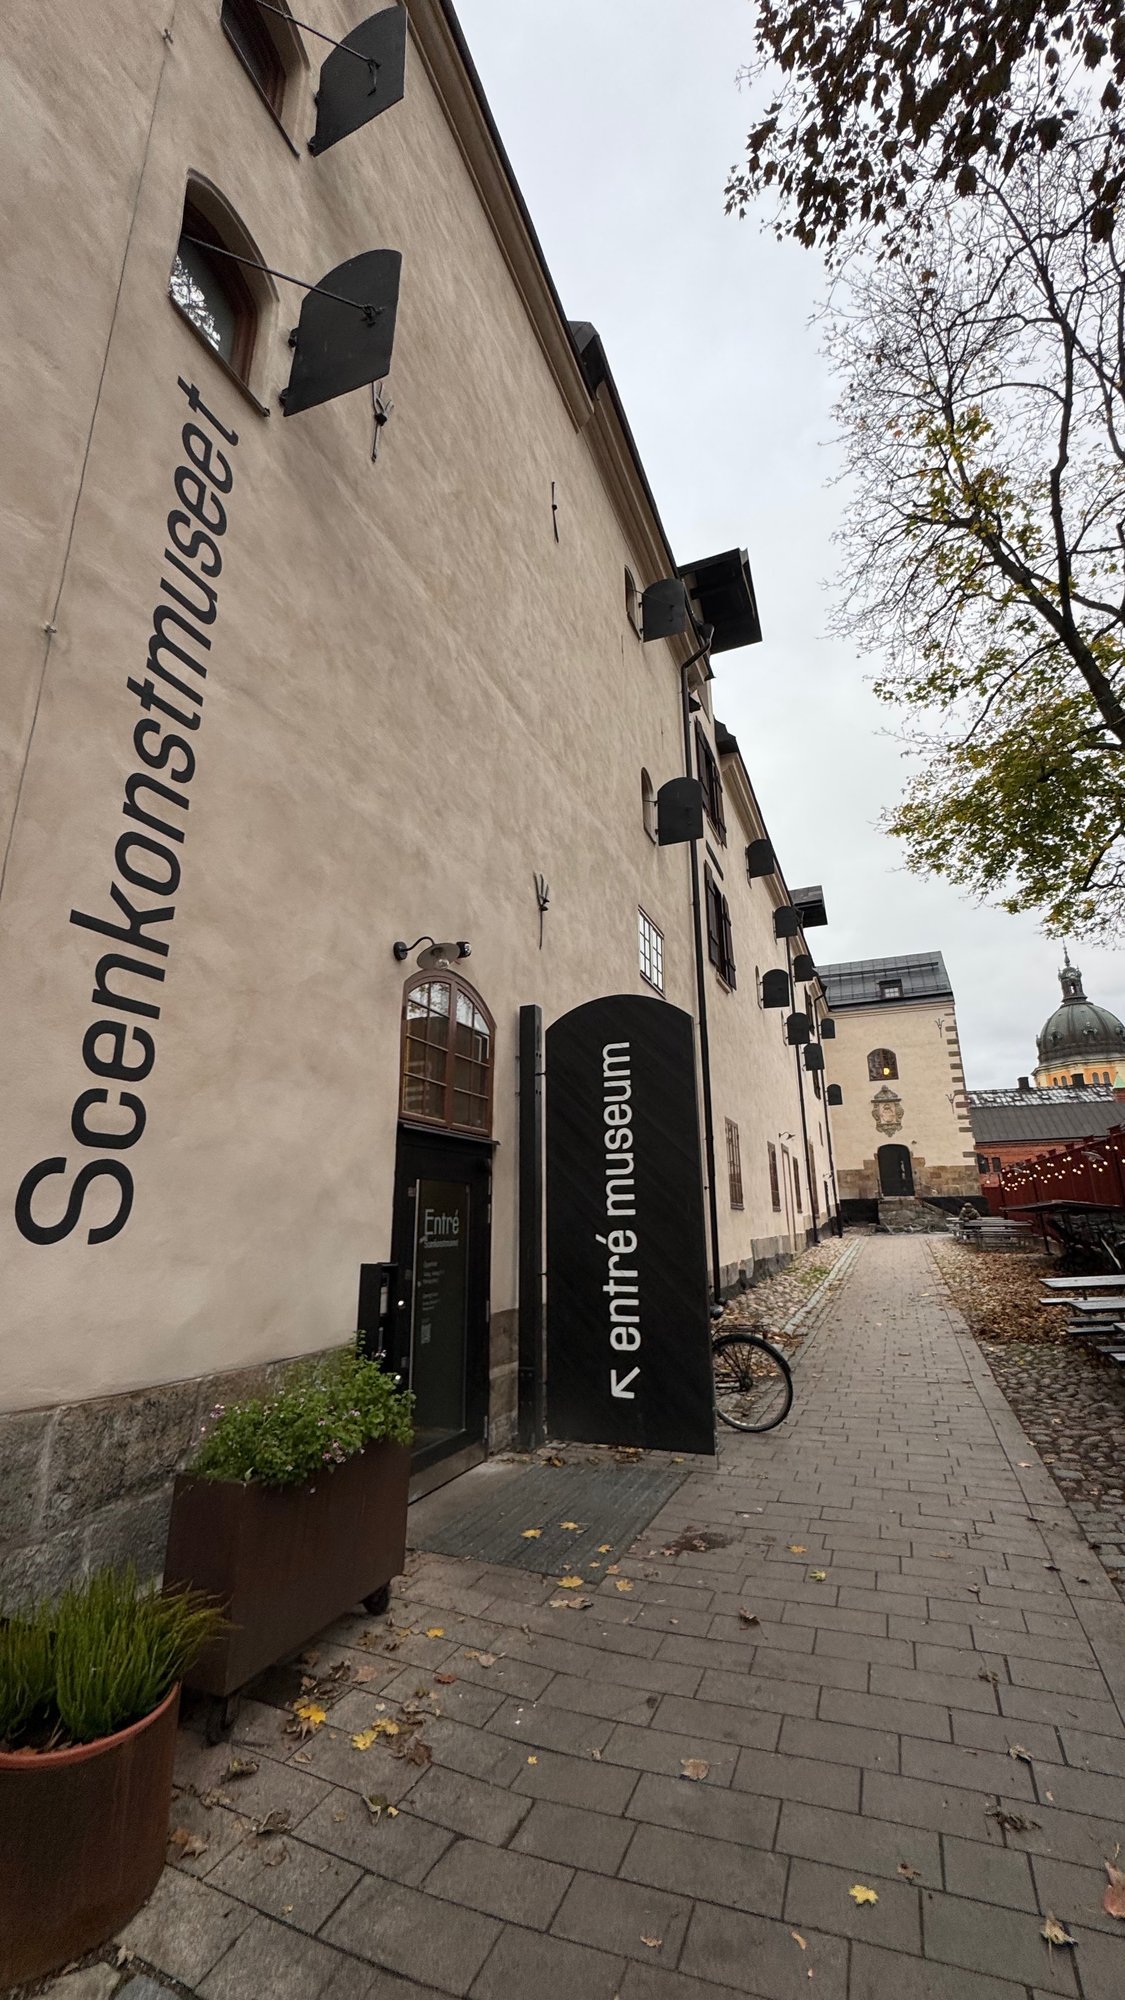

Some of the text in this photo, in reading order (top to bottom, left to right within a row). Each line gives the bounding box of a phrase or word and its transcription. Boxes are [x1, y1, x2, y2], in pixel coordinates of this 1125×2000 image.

[15, 375, 240, 1247] Scenkonstmuseet
[425, 1208, 460, 1235] Entré
[595, 1041, 642, 1352] entré museum
